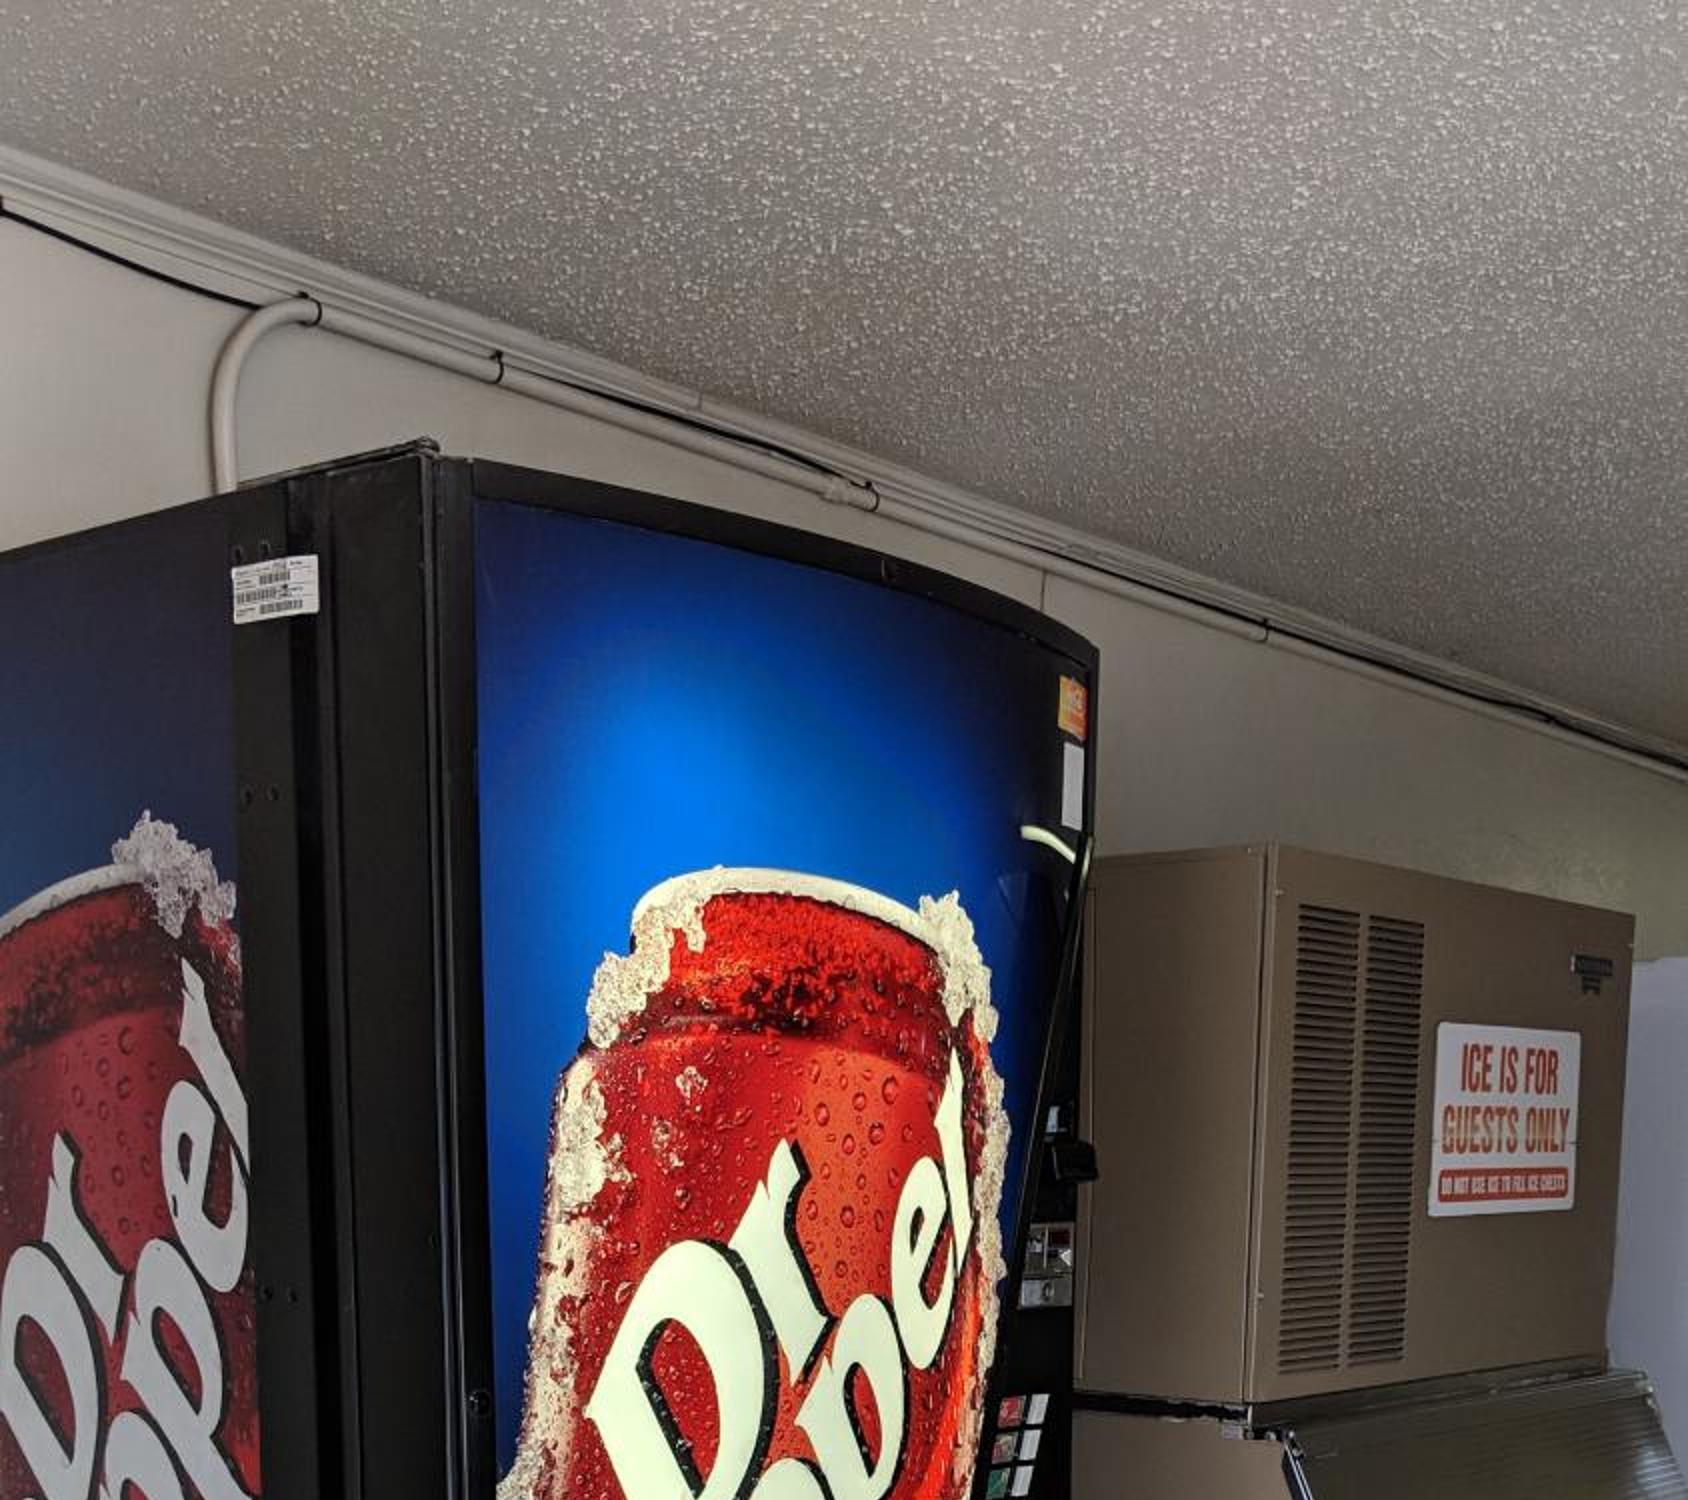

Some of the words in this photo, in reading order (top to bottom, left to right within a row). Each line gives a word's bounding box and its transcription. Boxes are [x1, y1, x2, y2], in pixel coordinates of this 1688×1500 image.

[1461, 1043, 1493, 1093] ICE
[1500, 1046, 1518, 1093] IS
[1524, 1047, 1559, 1094] FOR
[1442, 1105, 1518, 1154] GUESTS
[1525, 1107, 1570, 1153] ONLY
